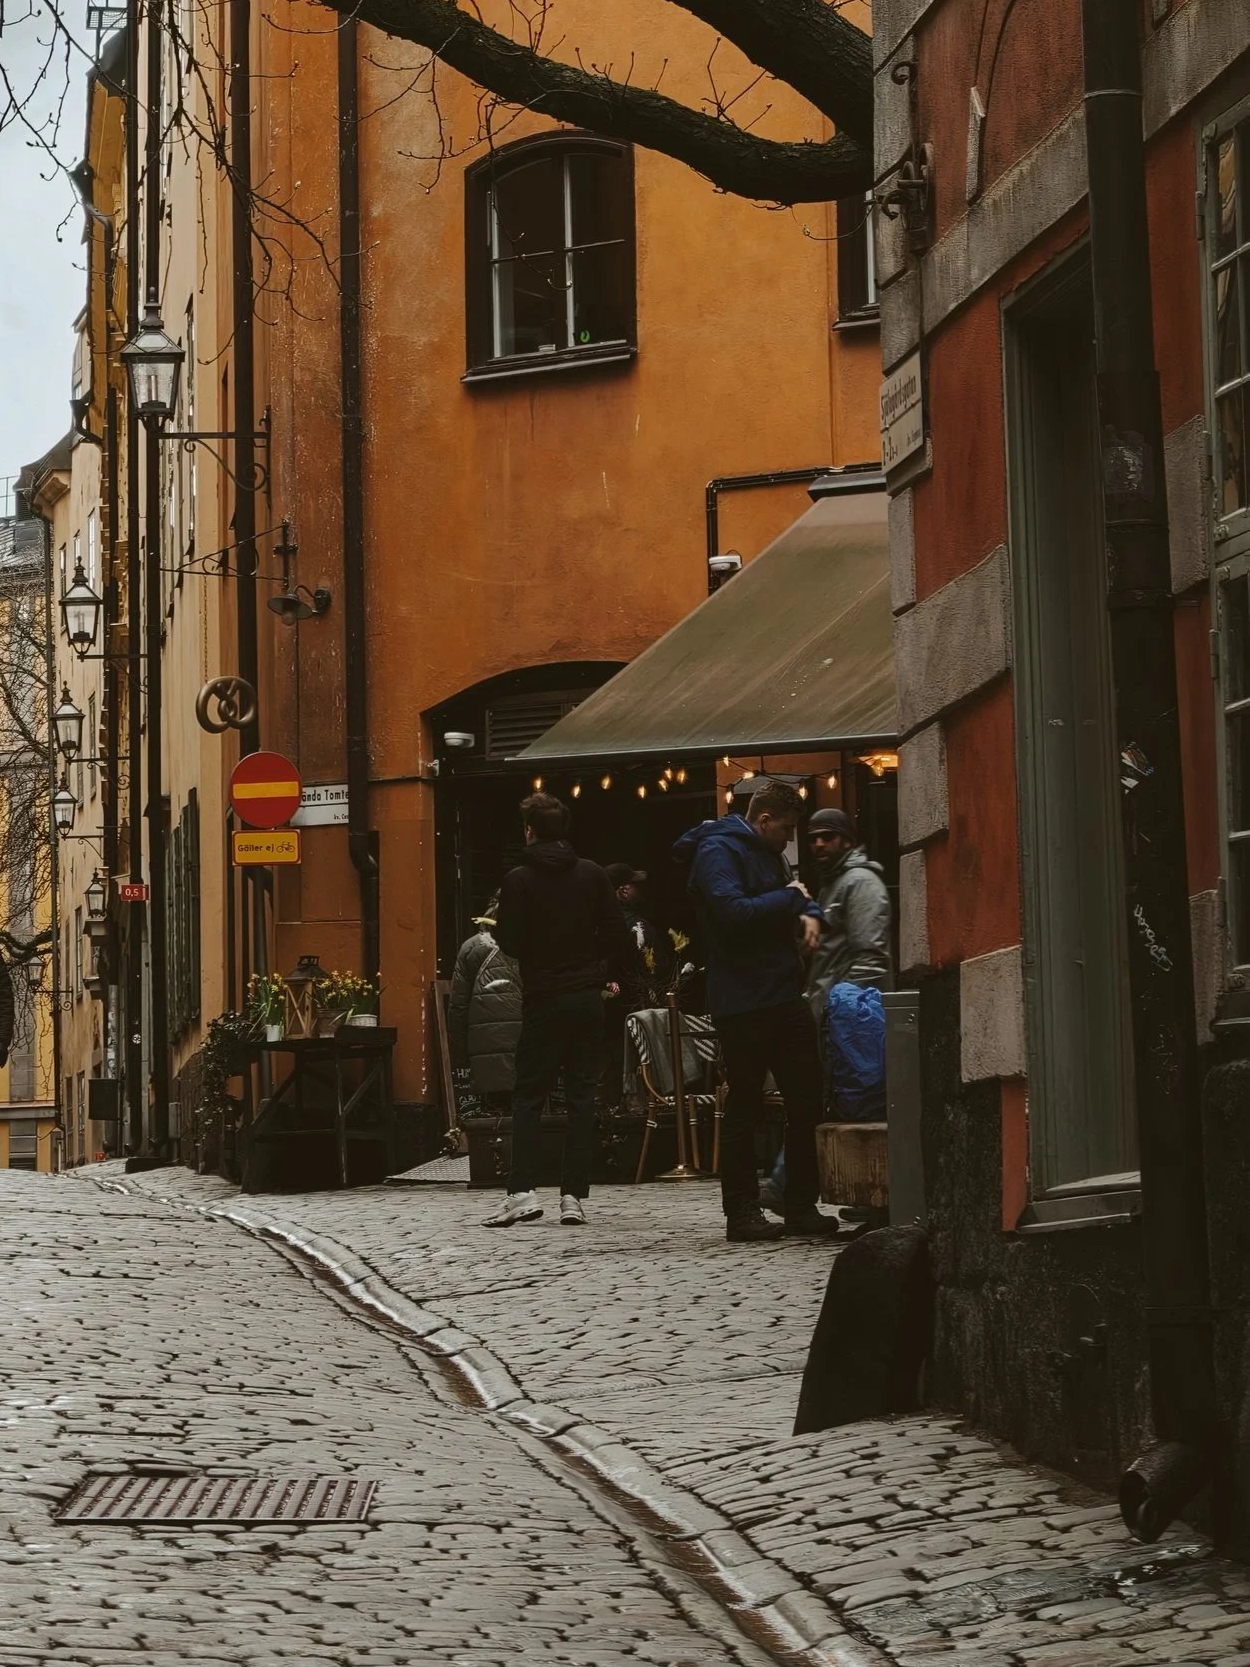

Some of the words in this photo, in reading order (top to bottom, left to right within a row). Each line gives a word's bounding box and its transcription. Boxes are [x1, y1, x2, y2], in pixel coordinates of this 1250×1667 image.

[302, 791, 321, 801] ända
[324, 790, 349, 800] Tomte
[238, 844, 263, 852] Gäller
[266, 844, 274, 853] ej
